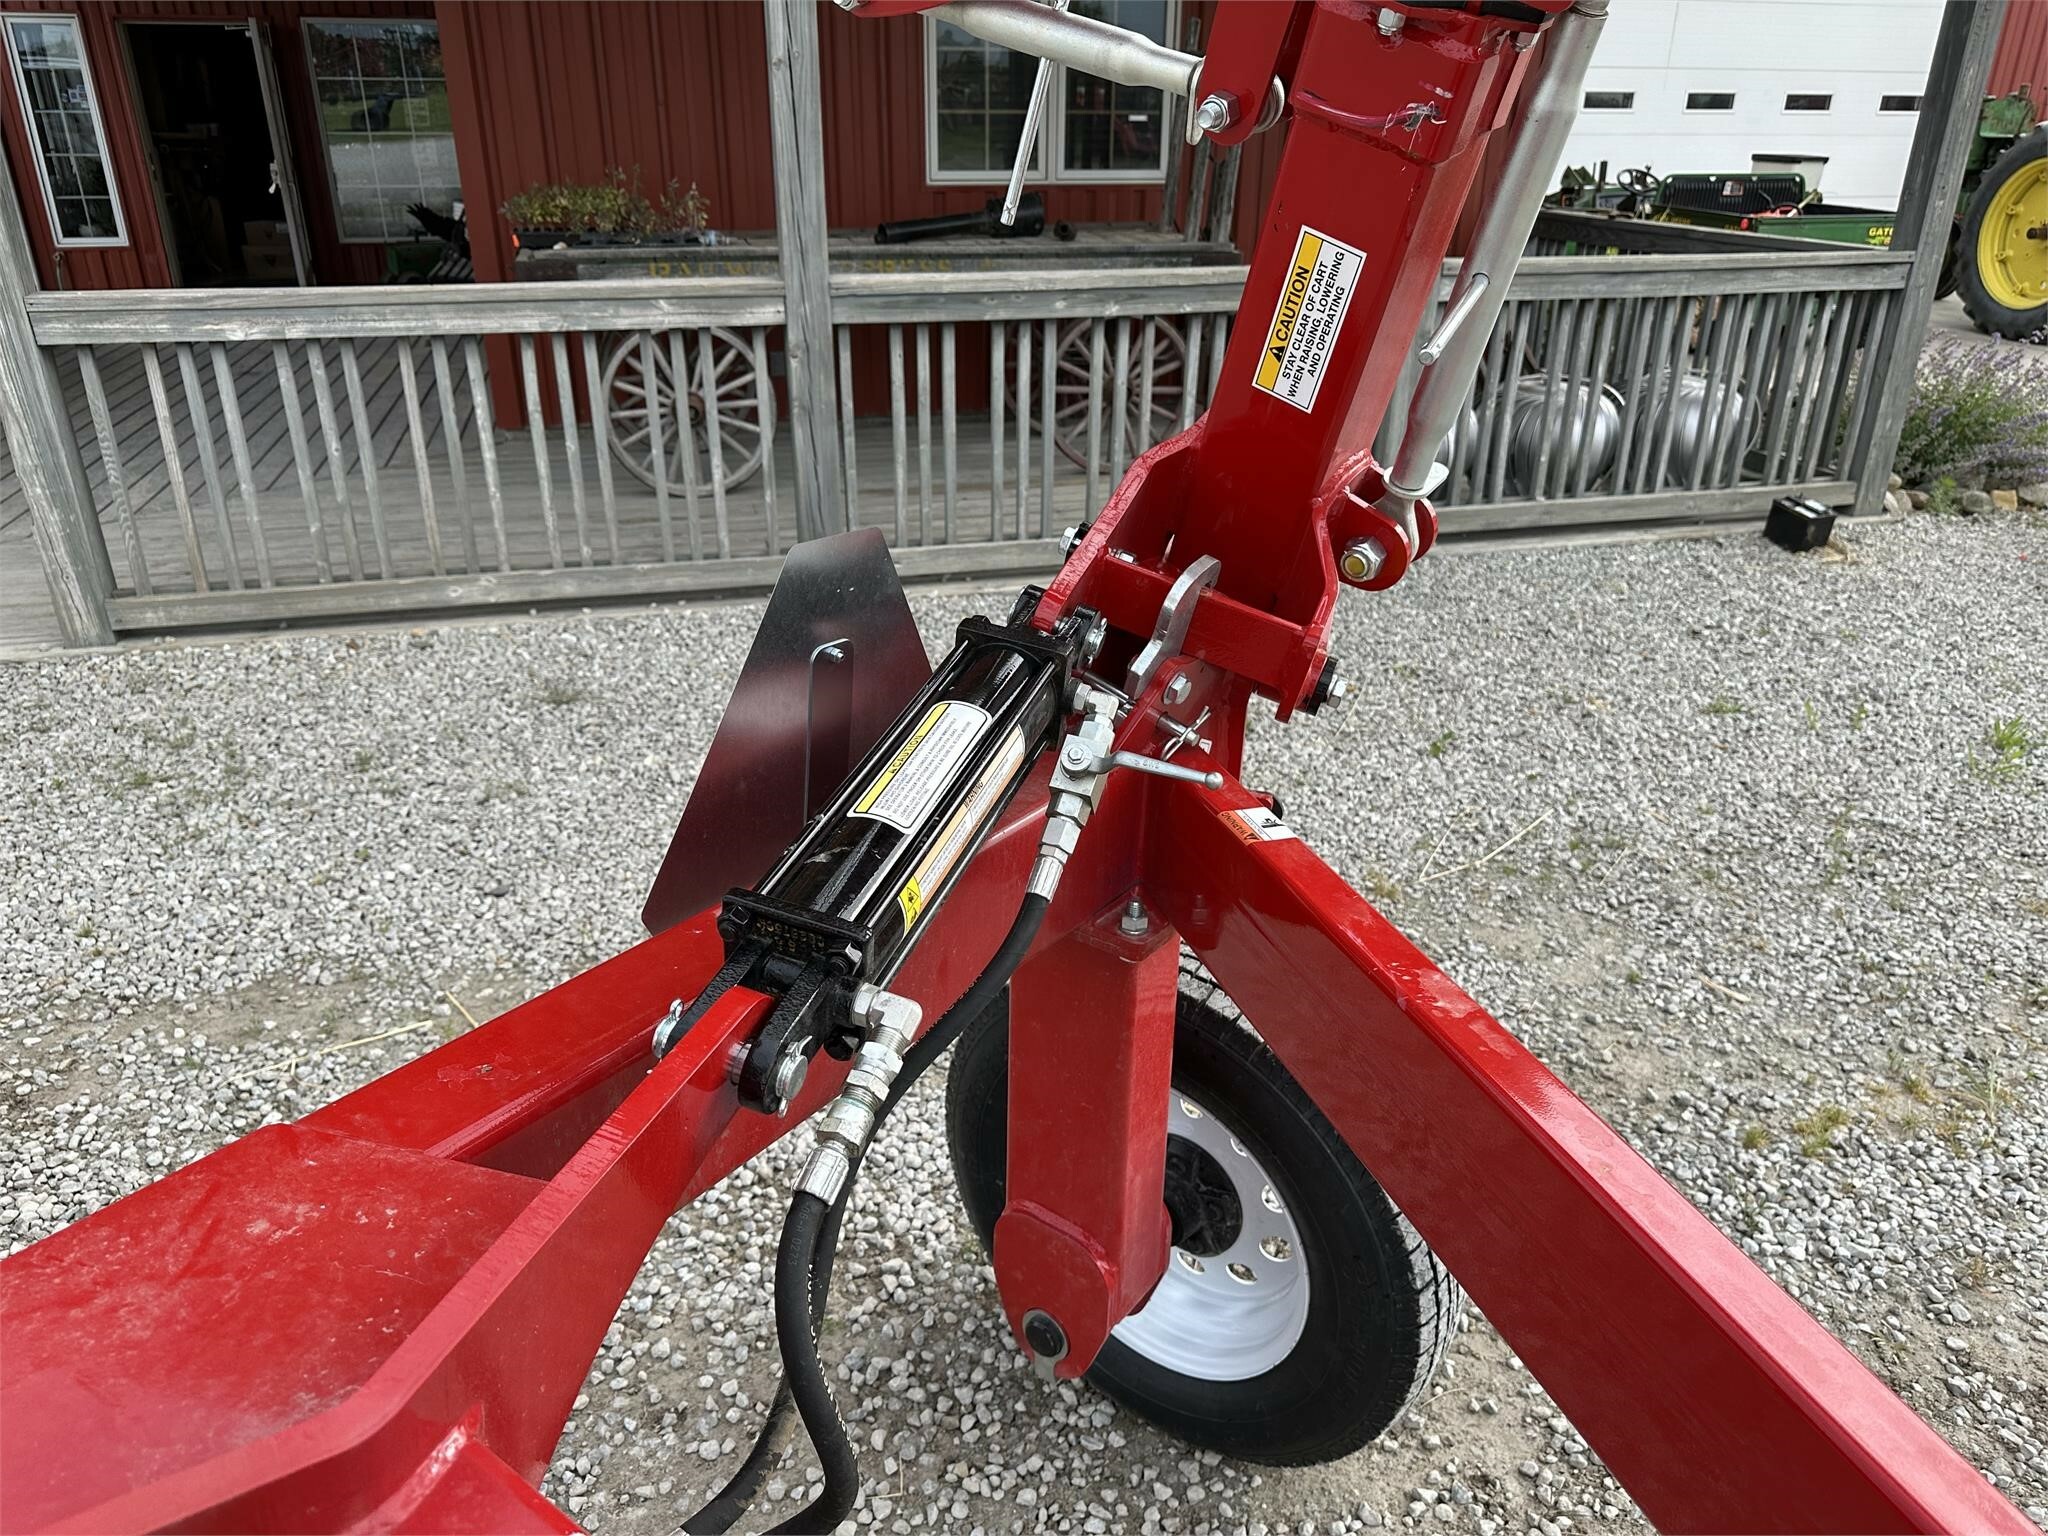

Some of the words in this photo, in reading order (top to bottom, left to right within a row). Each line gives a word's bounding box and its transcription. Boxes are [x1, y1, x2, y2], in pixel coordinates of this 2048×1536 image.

[1310, 261, 1328, 294] CART
[1275, 266, 1310, 342] CAUTION
[1304, 295, 1317, 312] OF
[1287, 364, 1305, 398] WHEN
[1299, 316, 1324, 364] RAISING,
[1316, 250, 1344, 313] LOWERING
[1292, 316, 1310, 351] CLEAR
[1306, 352, 1321, 377] AND
[1316, 286, 1345, 351] OPERATING
[1282, 352, 1298, 380] STAY
[892, 735, 923, 767] CAUTION
